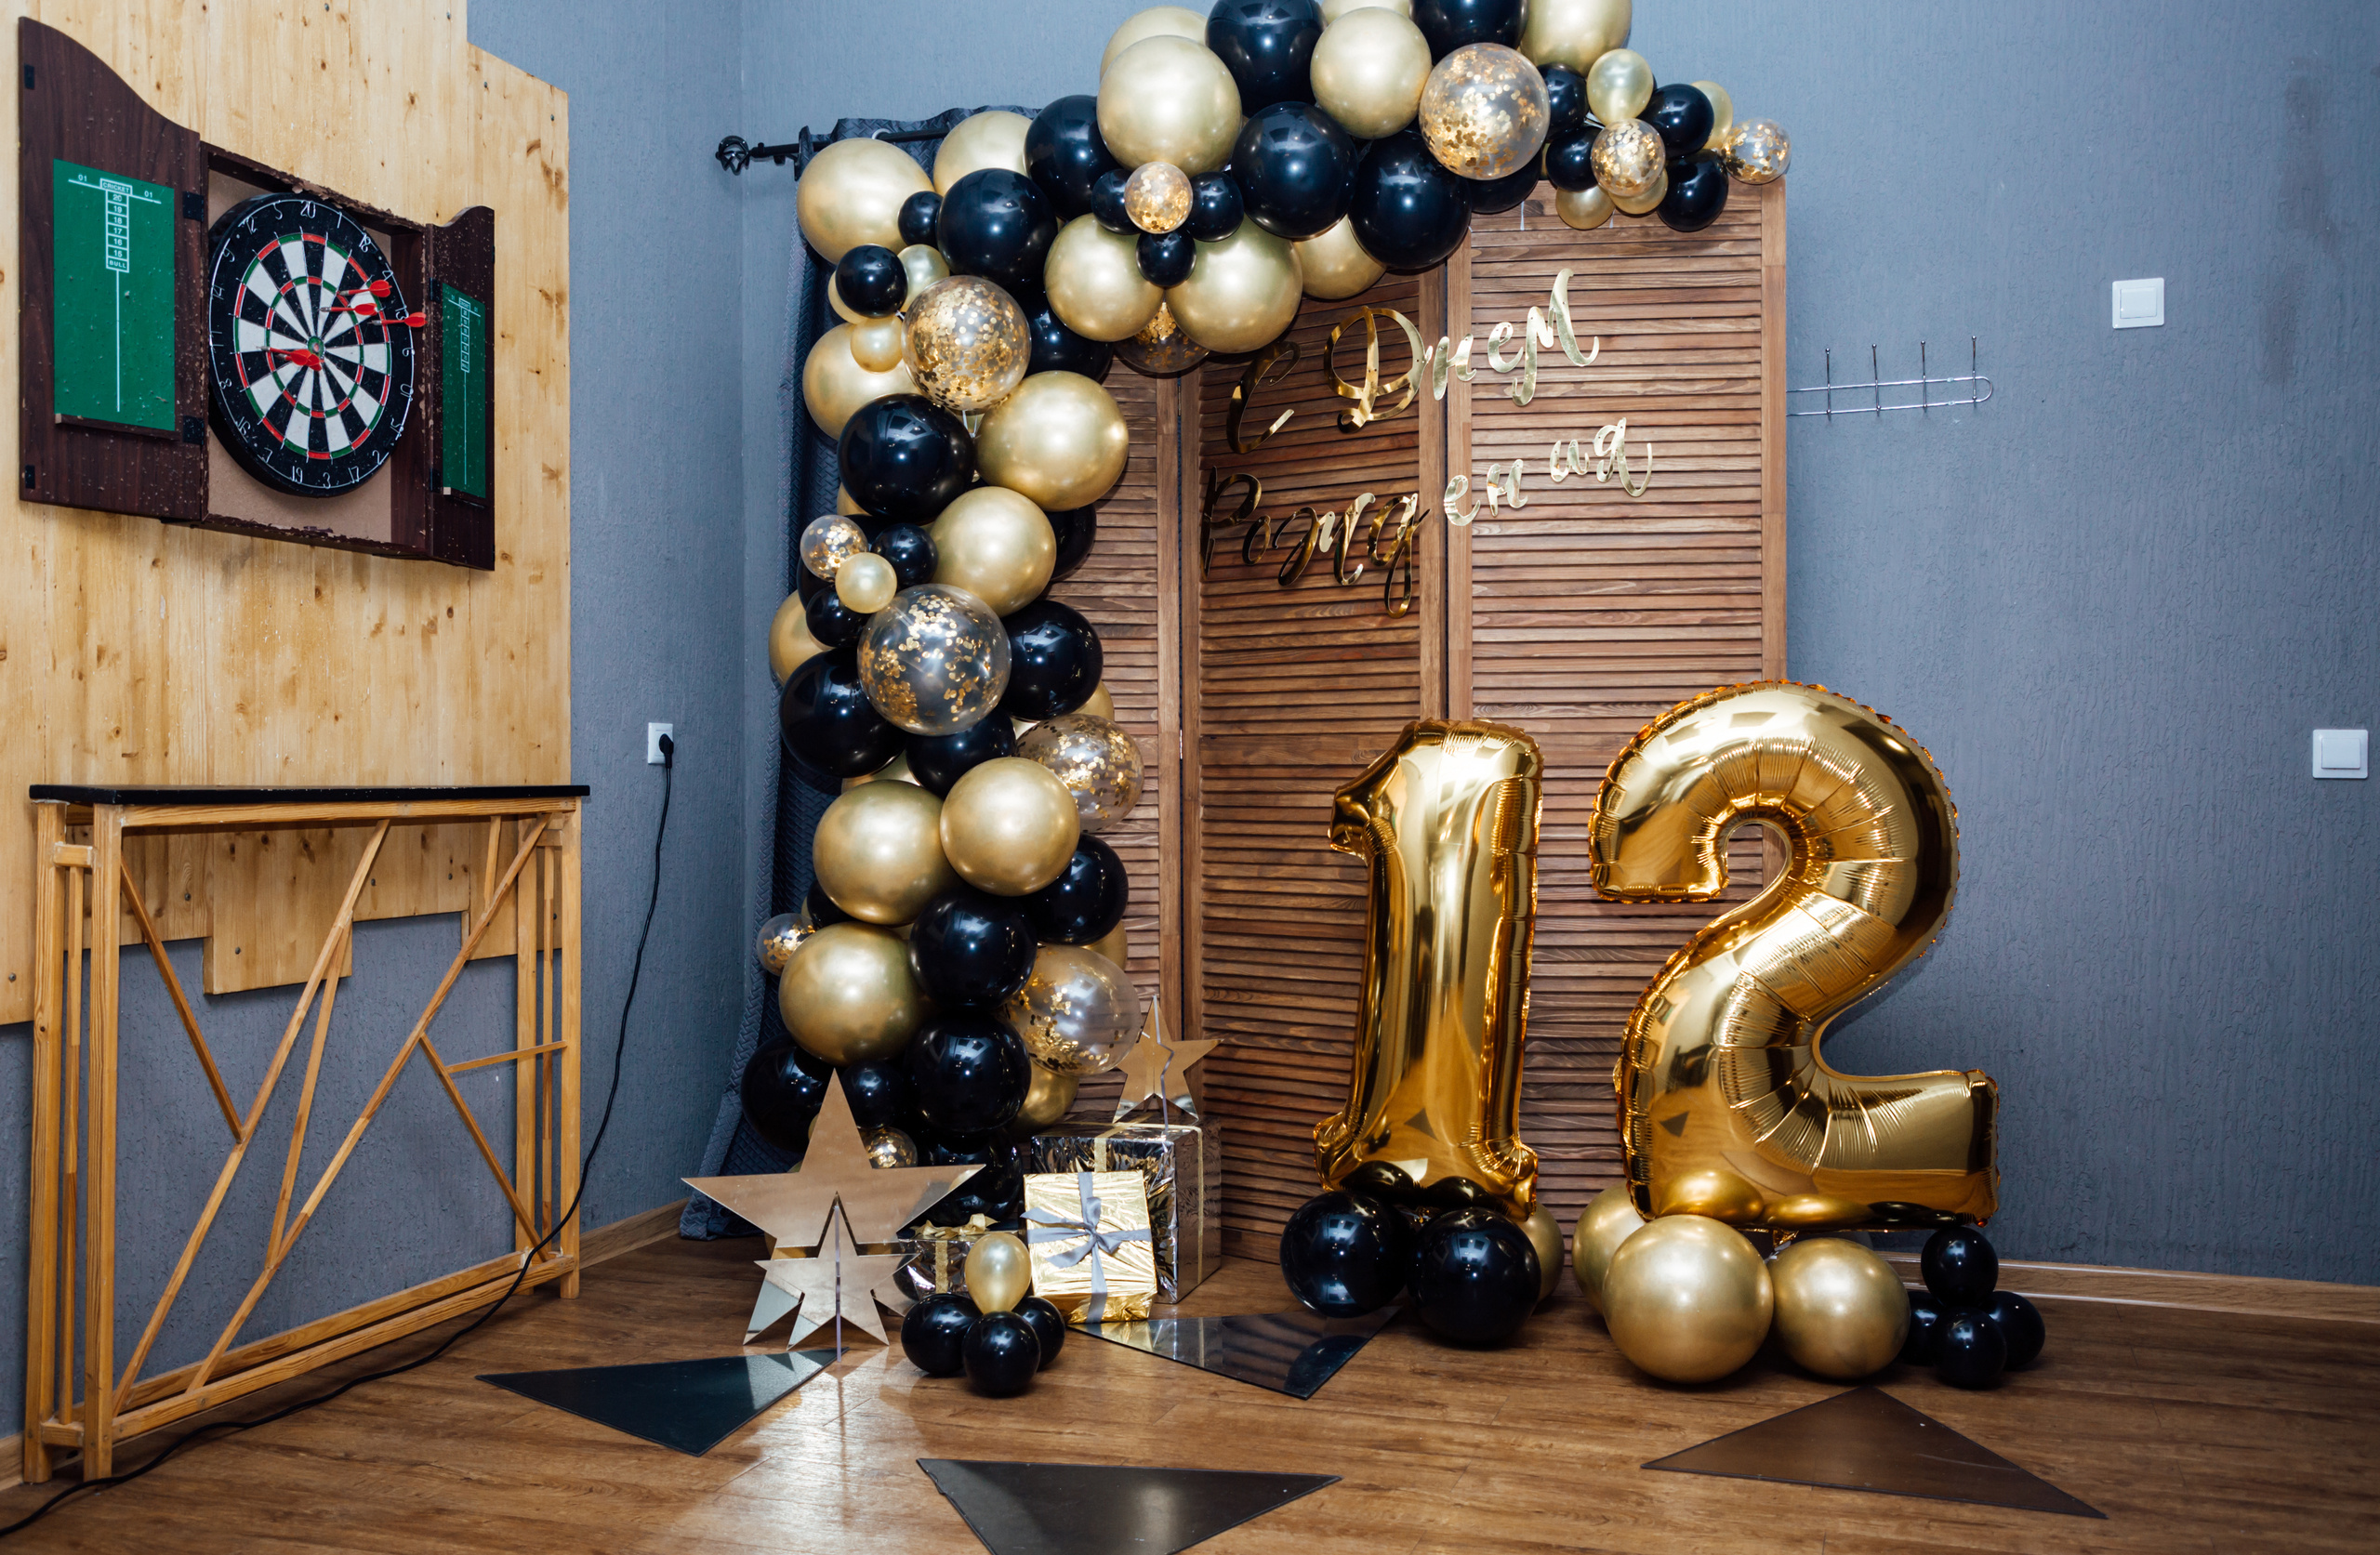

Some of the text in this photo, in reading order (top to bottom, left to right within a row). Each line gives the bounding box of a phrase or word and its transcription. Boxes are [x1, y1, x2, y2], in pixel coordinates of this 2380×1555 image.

[78, 174, 87, 182] 01
[102, 181, 129, 192] CRICKET
[112, 193, 123, 202] 20
[144, 190, 152, 198] 01
[113, 205, 122, 214] 19
[299, 200, 317, 219] 20
[113, 217, 122, 225] 18
[244, 216, 258, 235] 12
[113, 227, 122, 235] 17
[113, 238, 122, 246] 16
[359, 232, 372, 253] 18
[113, 249, 122, 257] 15
[109, 259, 126, 269] BULL
[394, 305, 410, 322] 13
[218, 377, 232, 390] 8
[400, 383, 414, 402] 10
[234, 415, 251, 437] 16
[372, 449, 383, 466] 2
[291, 465, 304, 484] 19
[322, 471, 332, 490] 3
[347, 465, 360, 483] 17
